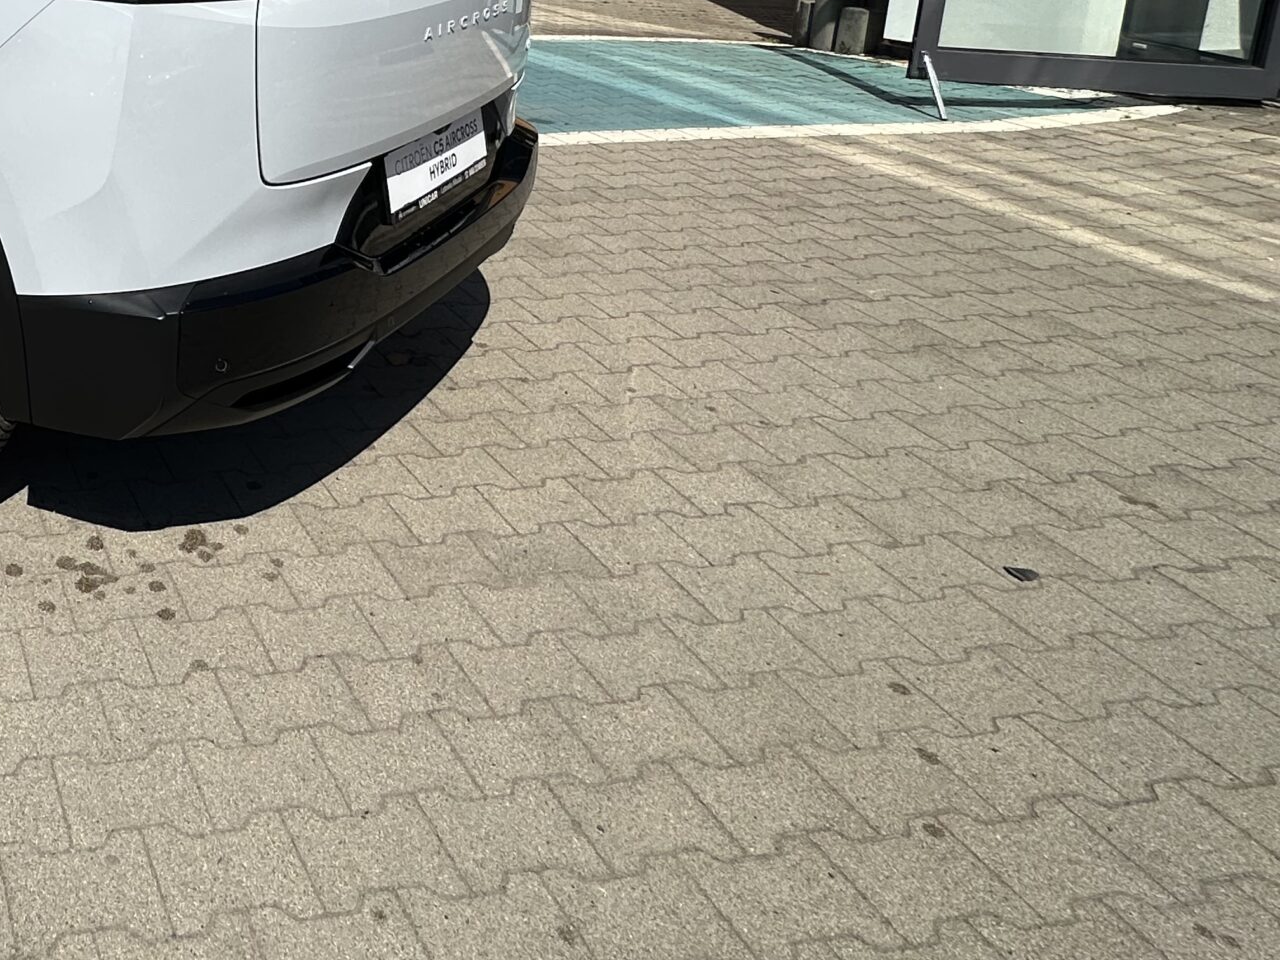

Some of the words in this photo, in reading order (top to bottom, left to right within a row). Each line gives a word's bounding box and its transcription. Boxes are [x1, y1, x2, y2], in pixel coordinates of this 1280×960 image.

[423, 0, 509, 42] AIRCROSS
[394, 142, 432, 175] CITROËN
[433, 138, 444, 155] C5
[445, 118, 478, 149] AIRCROSS
[428, 152, 458, 181] HYBRID
